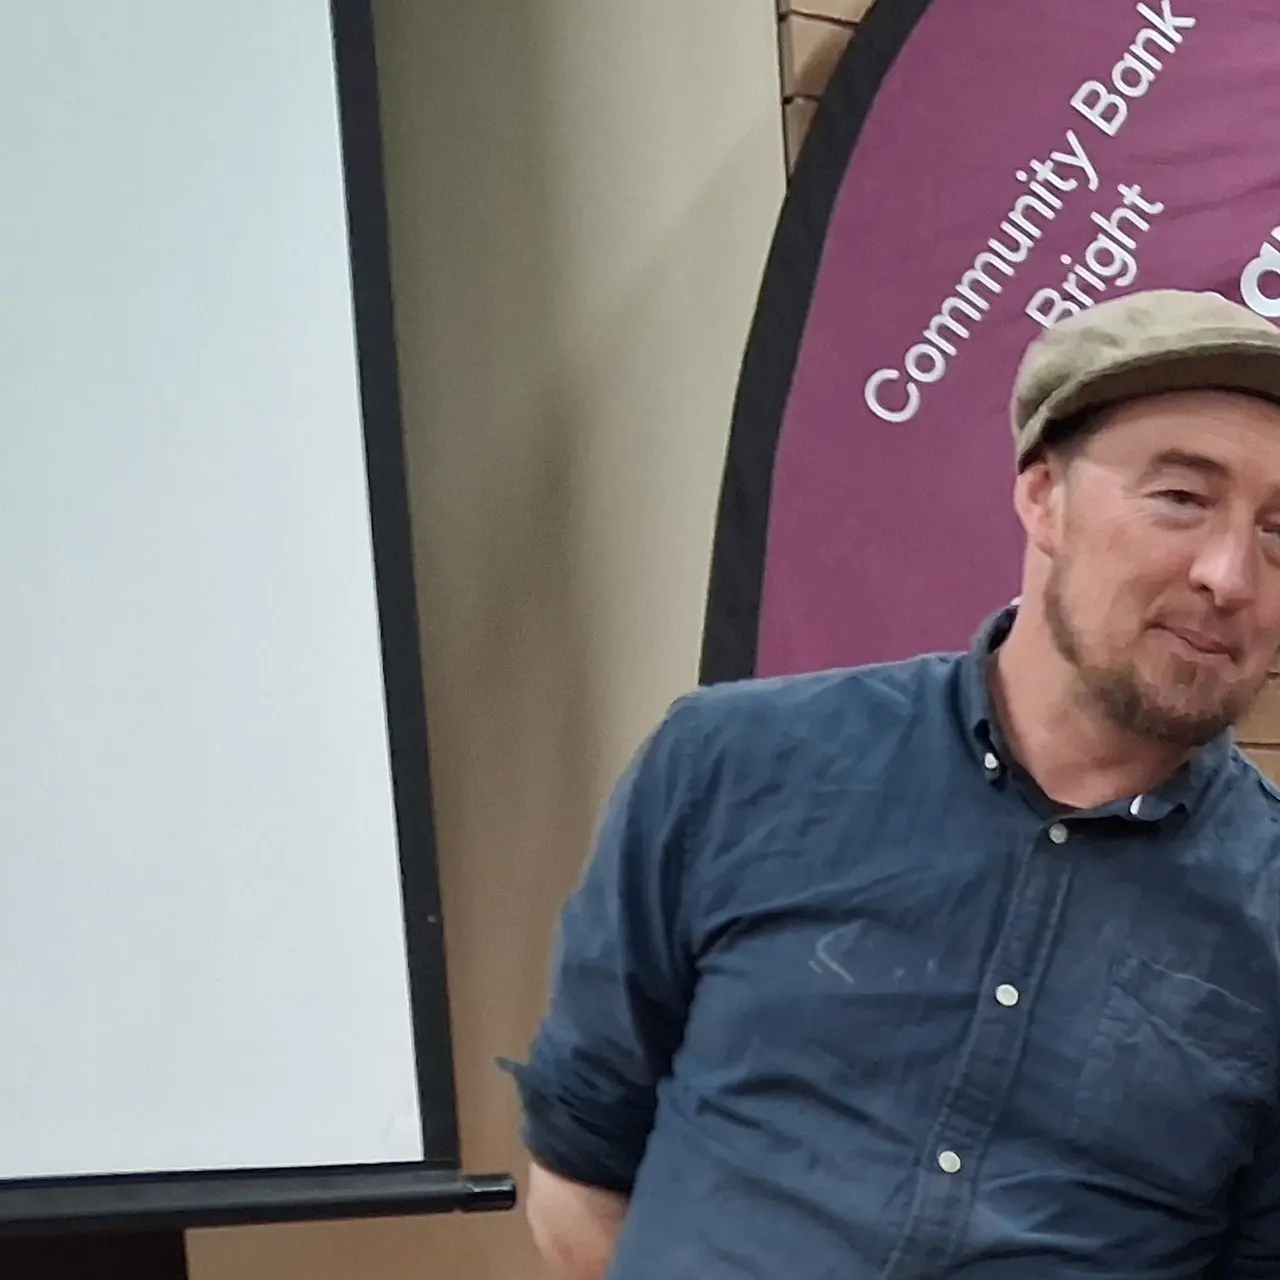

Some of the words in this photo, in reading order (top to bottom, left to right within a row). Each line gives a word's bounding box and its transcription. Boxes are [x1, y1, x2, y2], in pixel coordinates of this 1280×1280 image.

[863, 129, 1099, 423] Community
[1070, 0, 1196, 137] Bank
[1024, 184, 1164, 329] Bright
